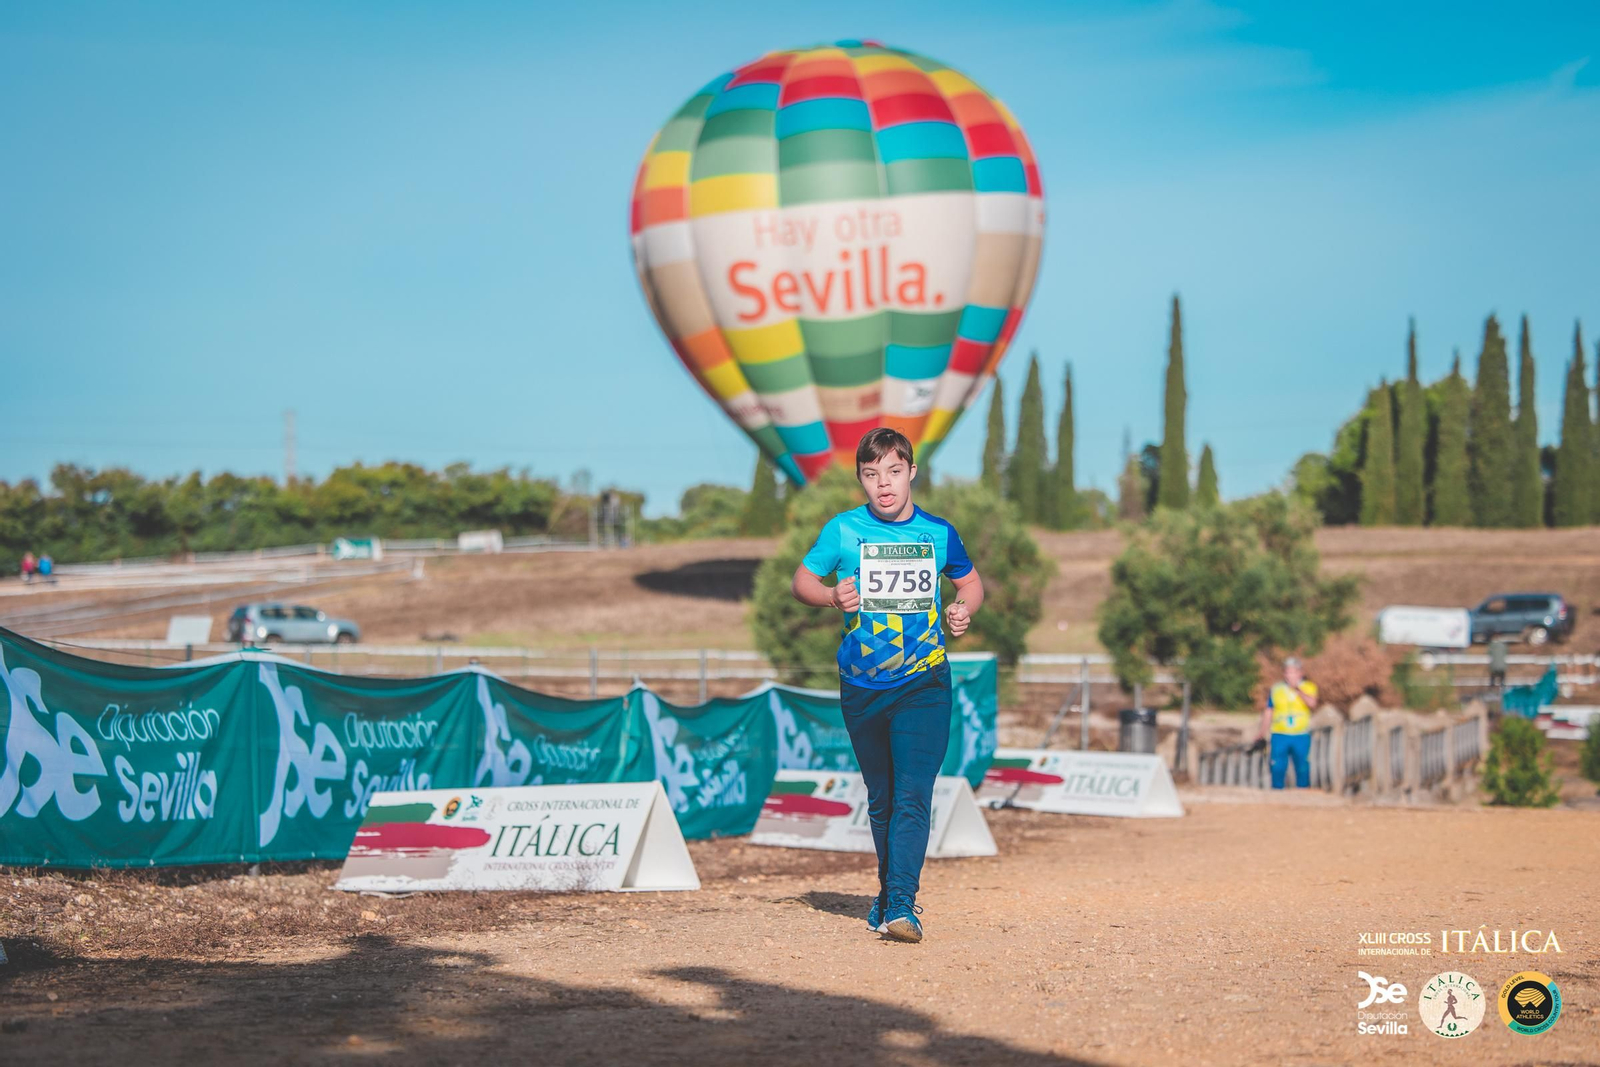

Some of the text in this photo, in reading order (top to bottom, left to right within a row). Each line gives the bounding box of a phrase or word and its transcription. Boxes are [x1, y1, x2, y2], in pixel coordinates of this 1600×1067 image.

[752, 202, 904, 252] Hay otra
[727, 245, 945, 322] Sevilla.
[868, 569, 932, 593] 5758
[97, 700, 220, 752] Diputación
[114, 752, 218, 823] Sevilla
[507, 798, 640, 812] CROSS INTERNACIONAL DE
[489, 814, 621, 858] ITÁLICA
